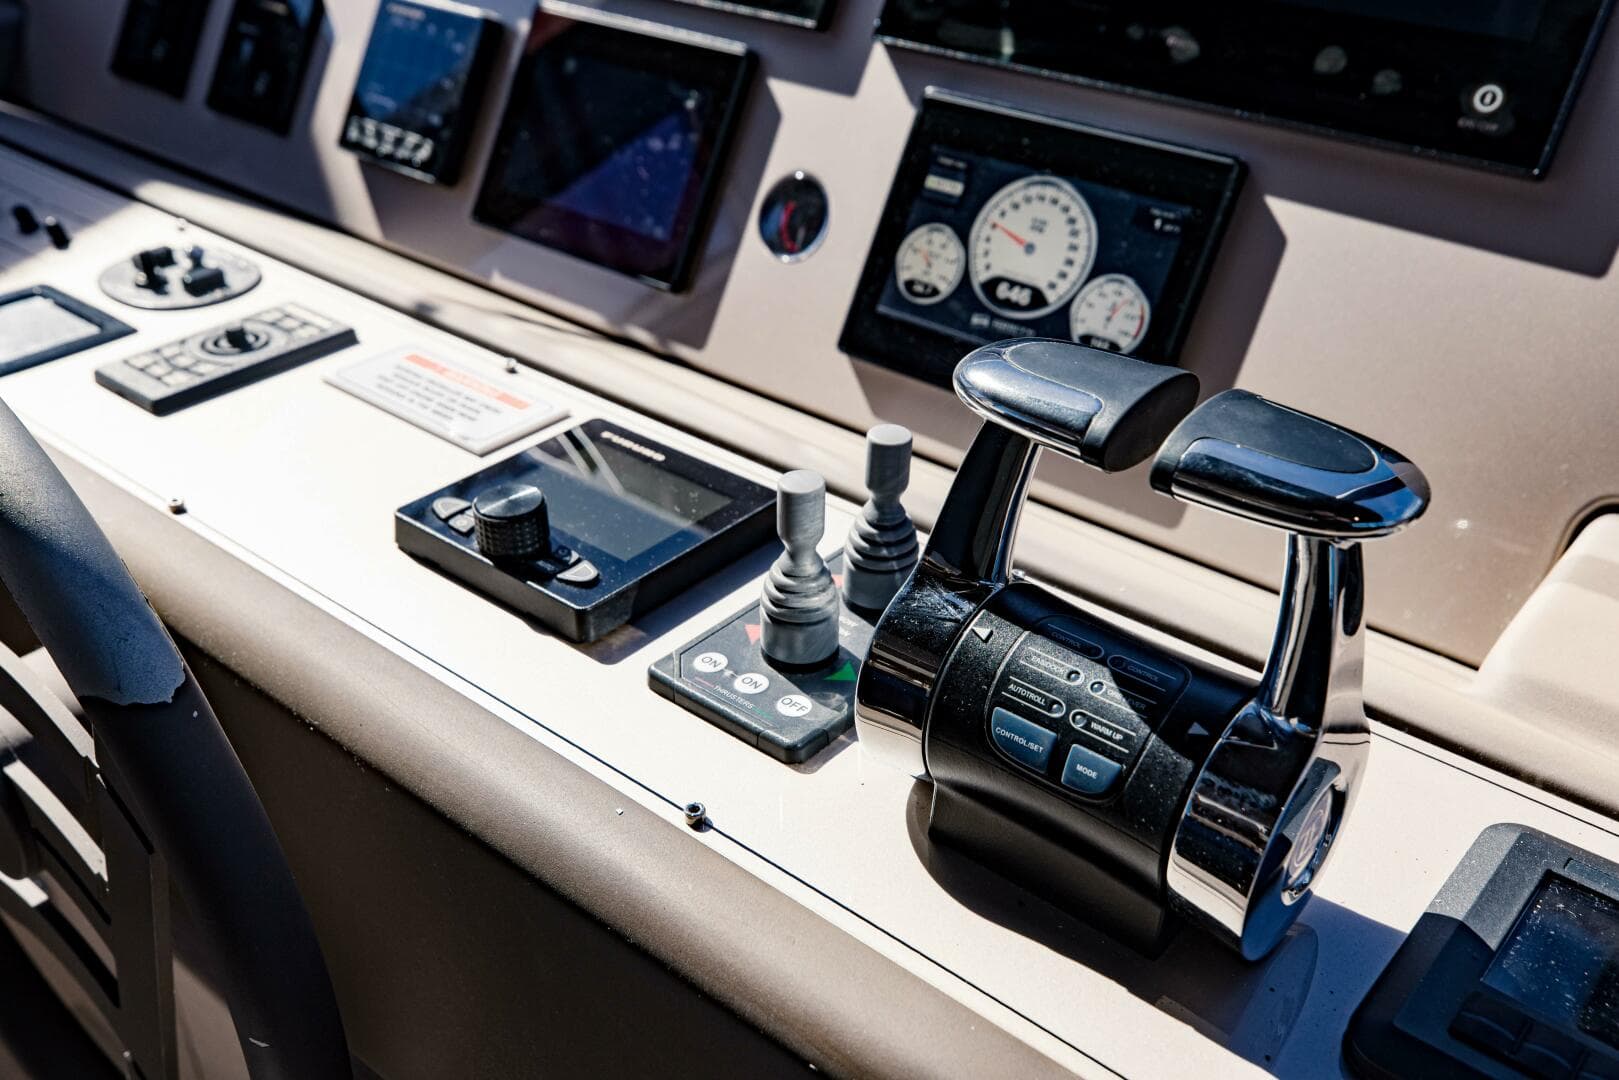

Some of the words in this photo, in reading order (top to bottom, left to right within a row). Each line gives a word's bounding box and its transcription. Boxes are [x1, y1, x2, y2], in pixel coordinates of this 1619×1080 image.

[1051, 632, 1081, 649] CONTROL
[701, 655, 722, 668] ON
[1127, 665, 1160, 683] CONTROL
[742, 676, 763, 690] ON
[1008, 683, 1046, 706] AUTOTROLL
[780, 697, 808, 712] OFF
[995, 727, 1044, 753] CONTROL/SET
[1112, 731, 1123, 740] UP
[1076, 763, 1098, 779] MODE
